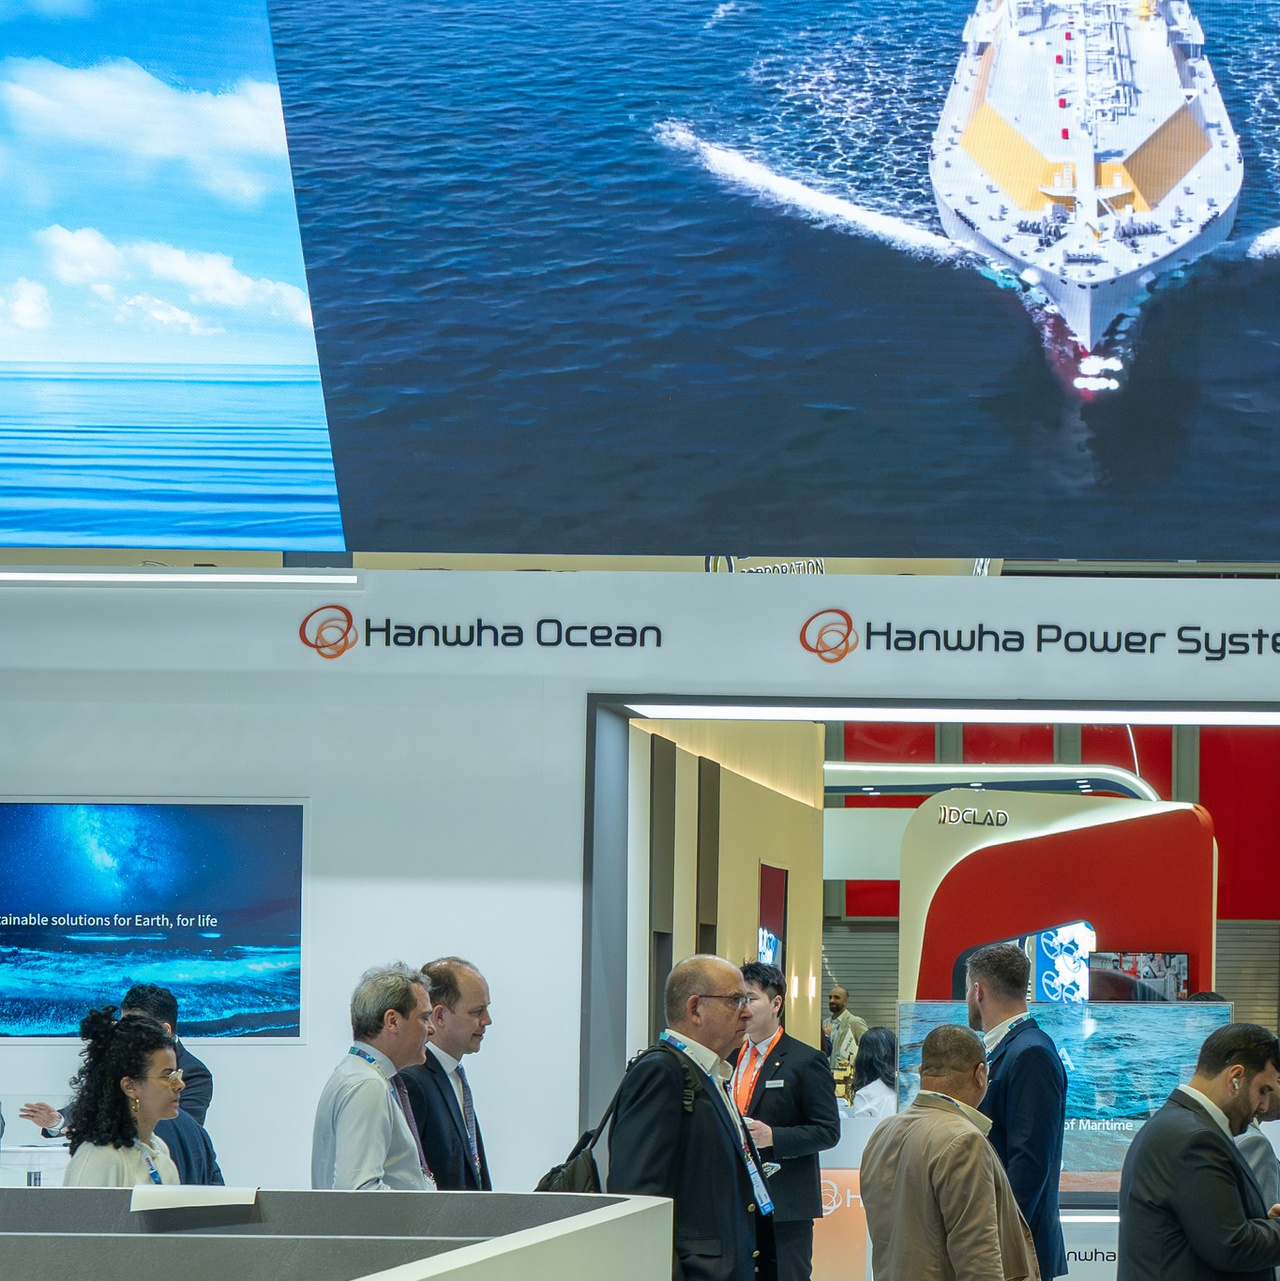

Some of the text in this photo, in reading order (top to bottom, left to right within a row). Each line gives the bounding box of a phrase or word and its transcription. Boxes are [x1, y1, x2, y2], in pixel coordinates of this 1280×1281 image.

[365, 619, 662, 648] Hanwha Ocean
[865, 622, 1024, 652] Hanwha
[1036, 624, 1166, 655] Power
[51, 914, 110, 926] solutions
[113, 914, 132, 926] for
[135, 915, 173, 929] Earth,
[176, 915, 195, 927] for
[198, 915, 218, 927] life
[1079, 1119, 1133, 1131] Maritime
